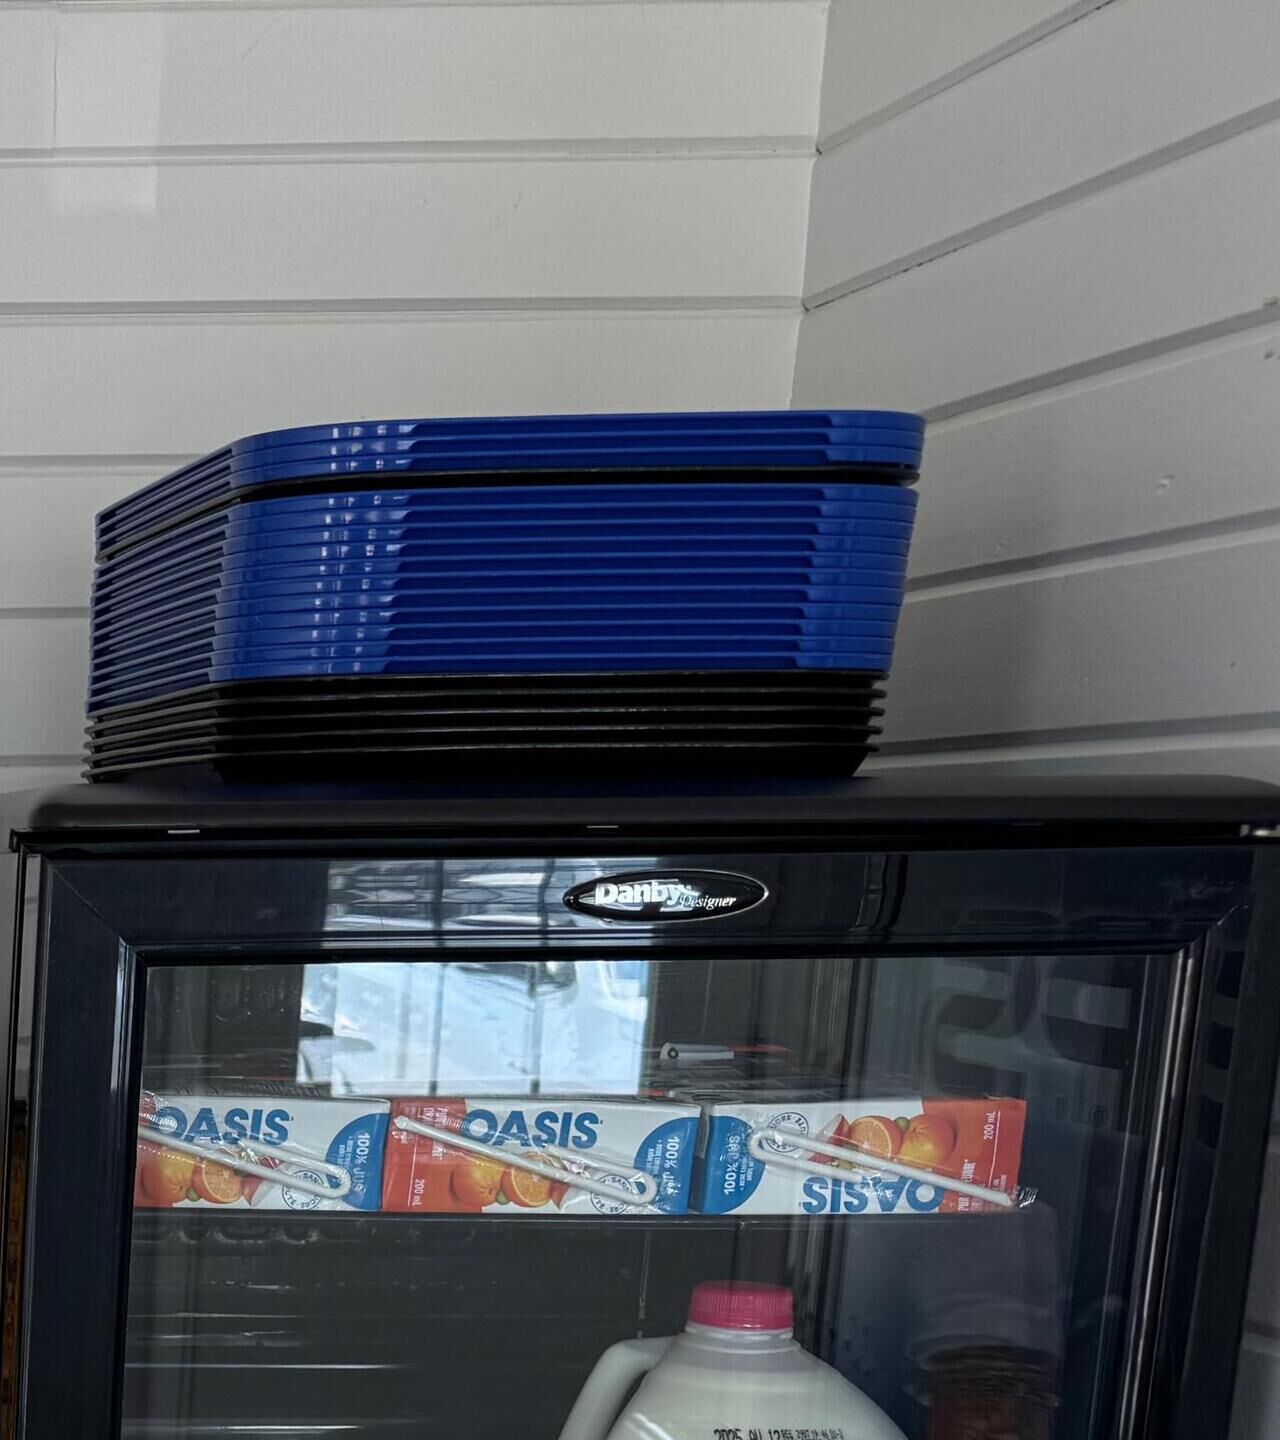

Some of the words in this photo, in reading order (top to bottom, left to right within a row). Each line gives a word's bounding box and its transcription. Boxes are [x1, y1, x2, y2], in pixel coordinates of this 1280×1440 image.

[595, 880, 696, 905] Danby
[679, 893, 736, 910] Designer
[156, 1107, 290, 1146] OASIS
[460, 1108, 599, 1150] OASIS
